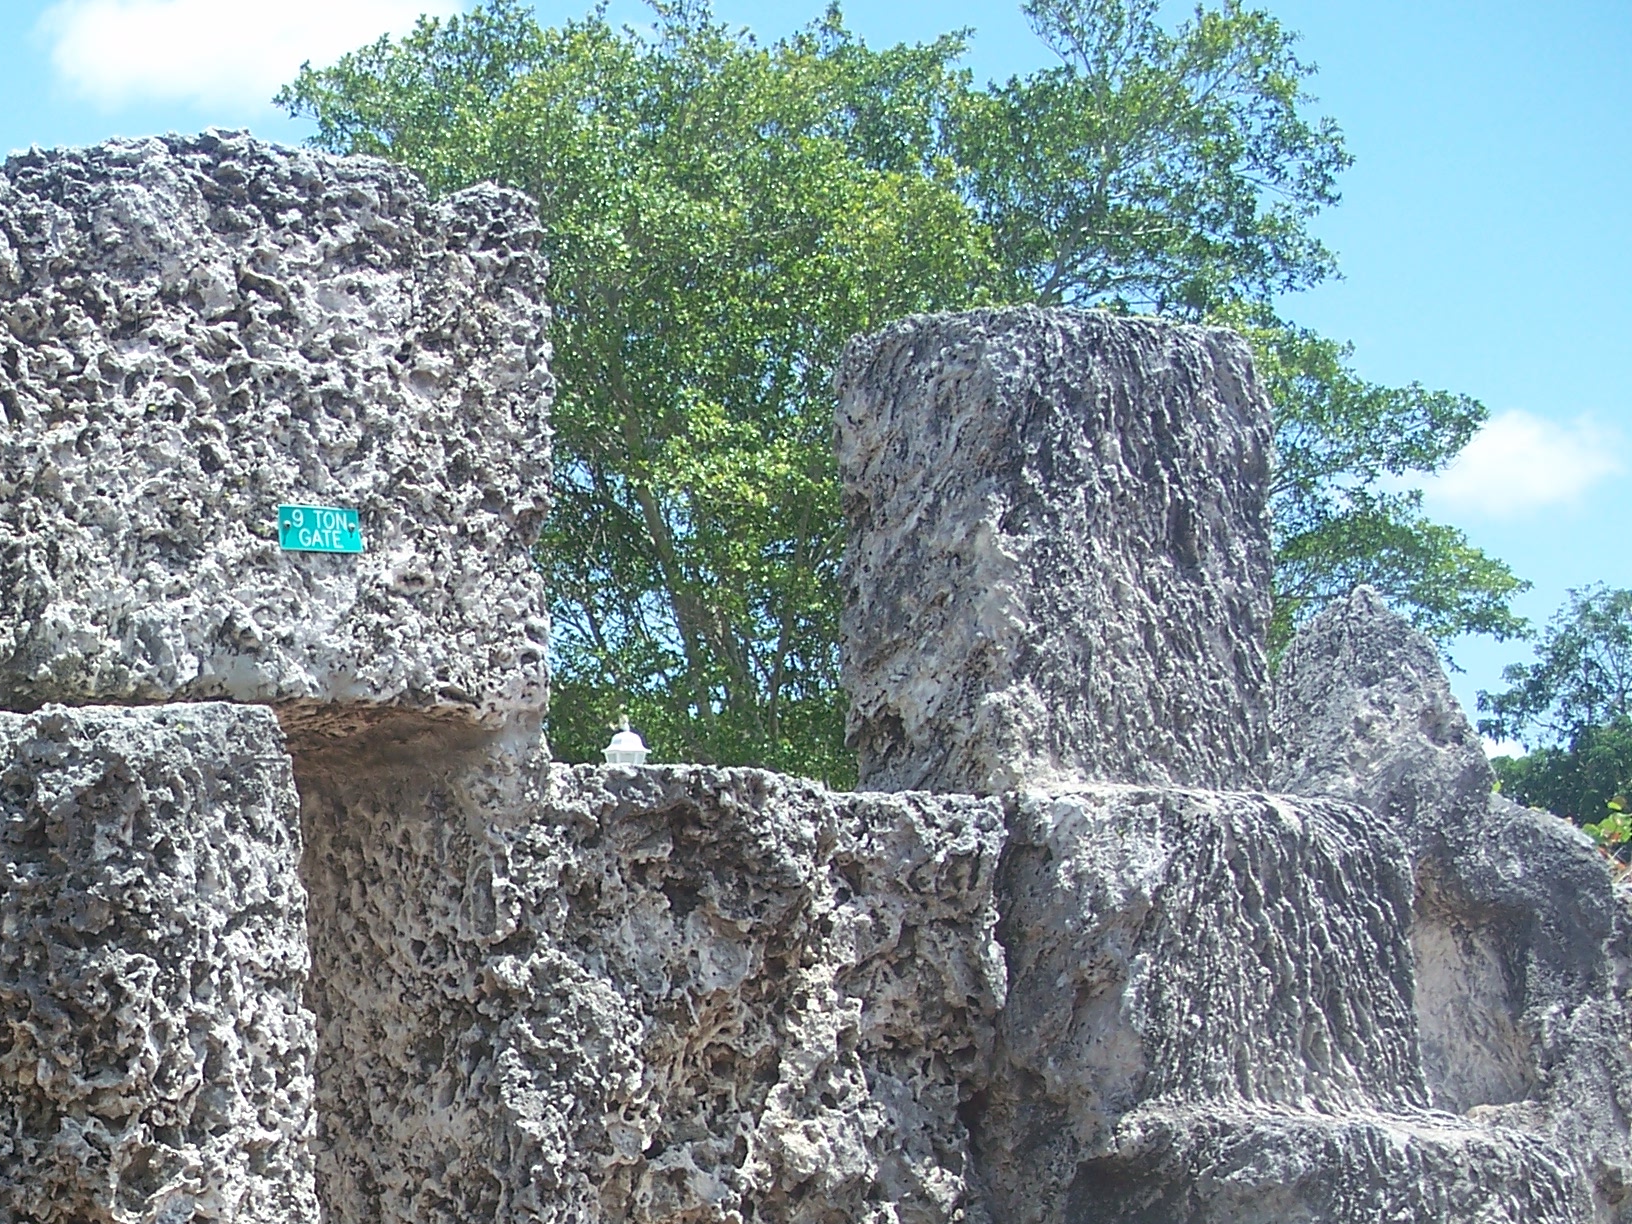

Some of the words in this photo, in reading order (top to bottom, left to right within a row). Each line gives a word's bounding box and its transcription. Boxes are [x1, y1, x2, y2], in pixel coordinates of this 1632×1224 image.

[292, 509, 304, 528] 9
[313, 510, 348, 531] TON
[298, 528, 344, 549] GATE
